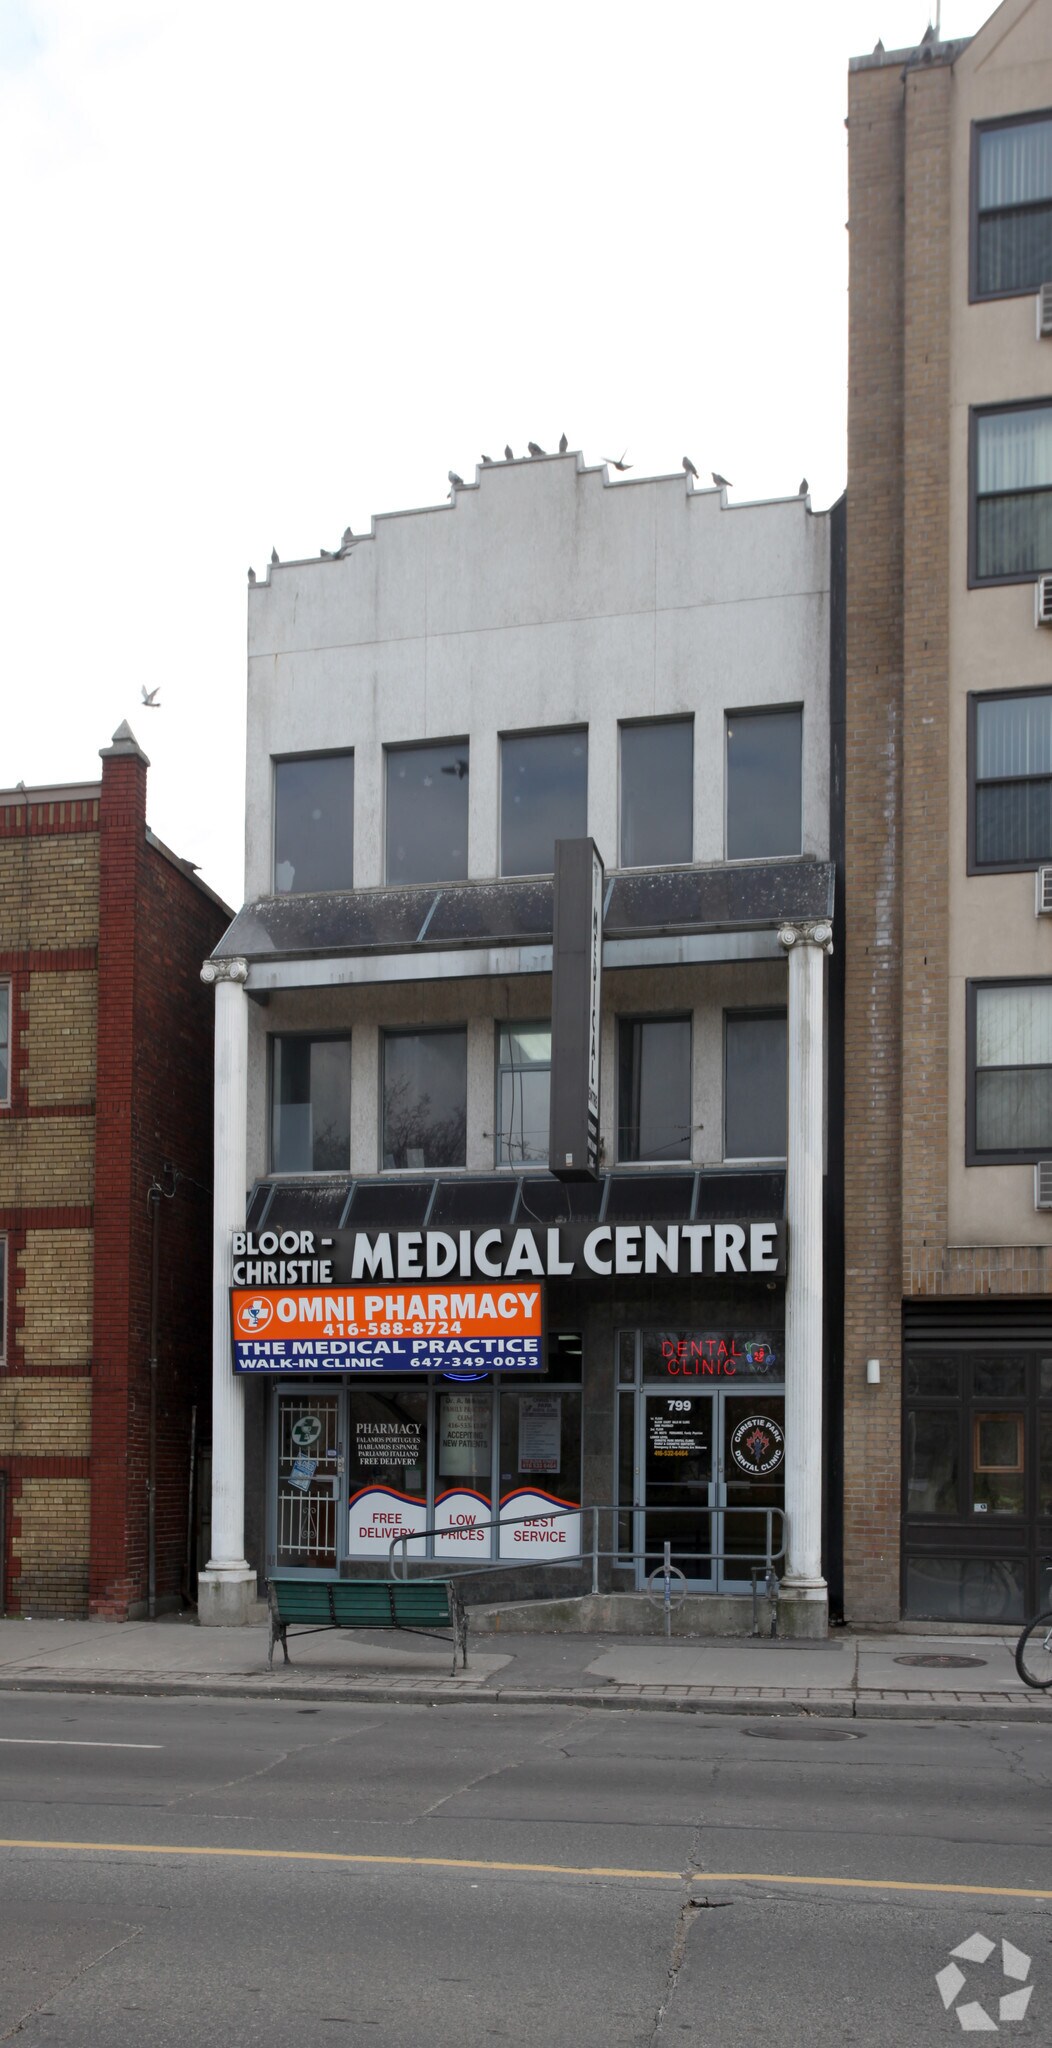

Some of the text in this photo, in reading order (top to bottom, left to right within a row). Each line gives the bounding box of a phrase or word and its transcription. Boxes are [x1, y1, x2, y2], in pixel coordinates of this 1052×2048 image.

[351, 1223, 778, 1279] MEDICAL CENTRE
[232, 1260, 332, 1285] CHRISTIE
[276, 1292, 538, 1323] OMNI PHARMACY
[323, 1321, 462, 1336] 416-588-8724
[238, 1338, 538, 1356] THE MEDICAL PRACTICE
[661, 1340, 742, 1357] DENTAL
[239, 1356, 539, 1369] WALK-IN CLINIC 647-349-0053
[667, 1358, 737, 1375] CLINIC
[667, 1400, 692, 1412] 799
[356, 1423, 422, 1434] PHARMACY
[734, 1419, 782, 1443] CHRISTIE PARK
[442, 1440, 488, 1448] NEW PATIENTS
[735, 1449, 782, 1471] DENTAL CLINIC
[372, 1512, 402, 1524] FREE
[449, 1514, 476, 1526] LOW
[523, 1517, 556, 1528] BEST
[359, 1527, 415, 1539] DELIVERY
[441, 1529, 485, 1541] PRICES
[513, 1530, 566, 1543] SERVICE
